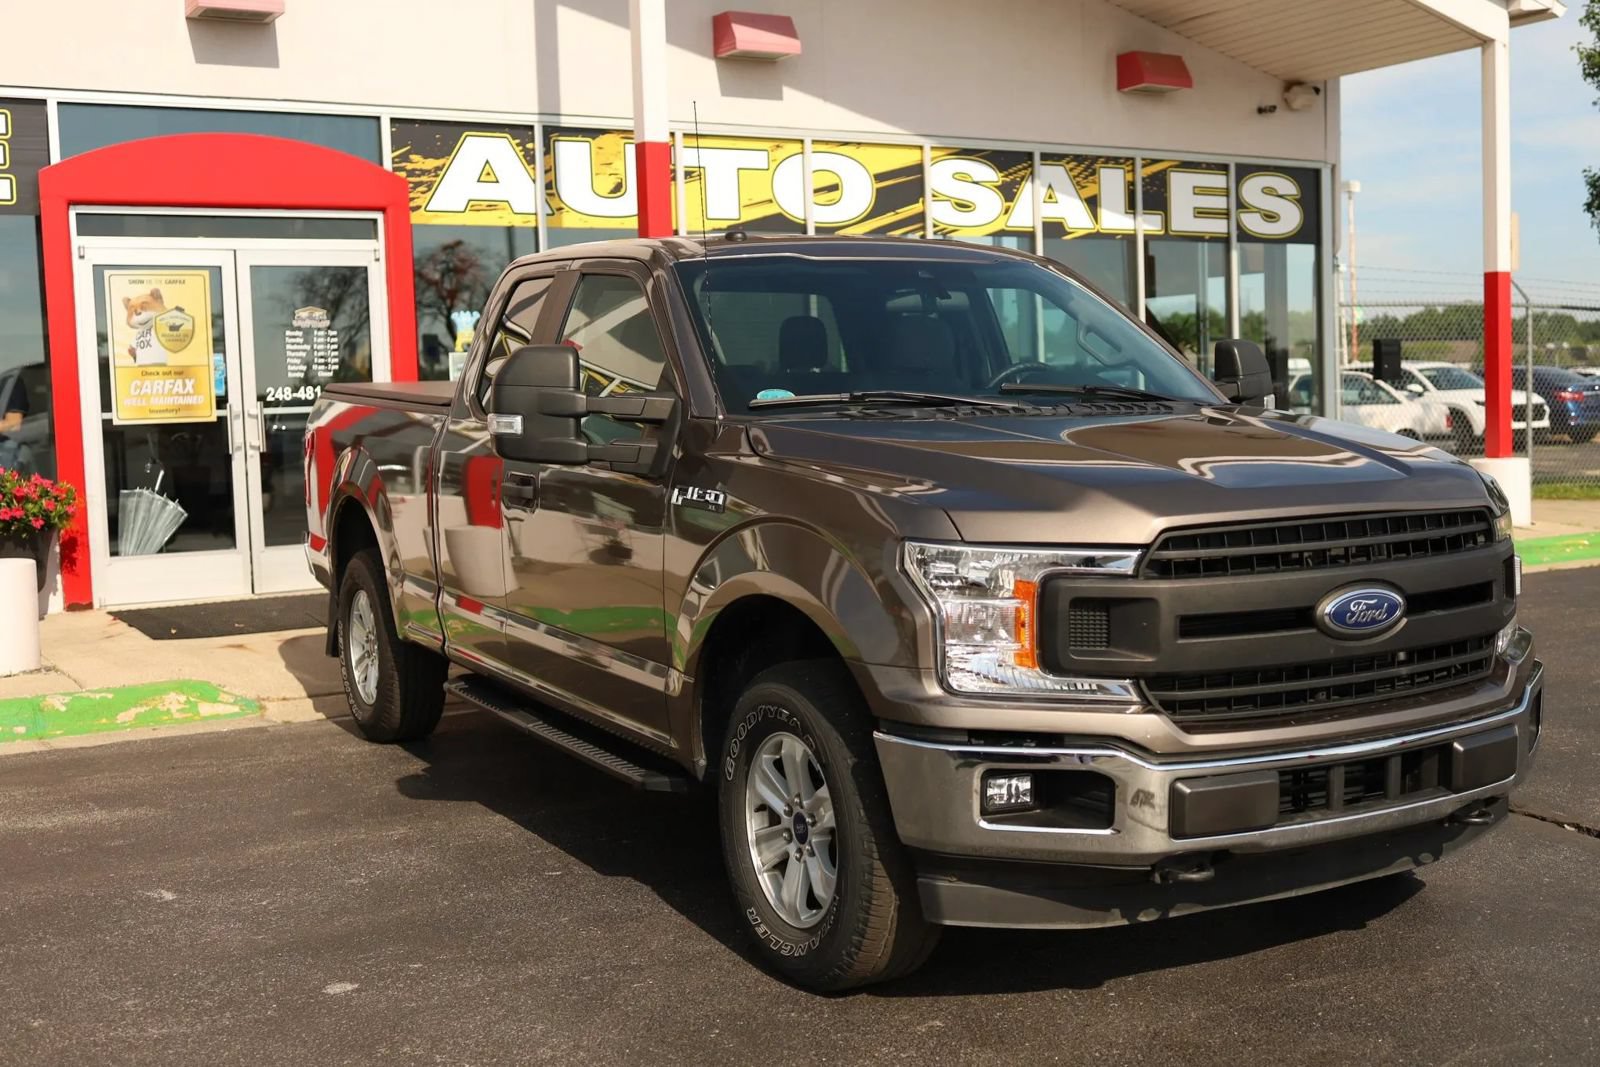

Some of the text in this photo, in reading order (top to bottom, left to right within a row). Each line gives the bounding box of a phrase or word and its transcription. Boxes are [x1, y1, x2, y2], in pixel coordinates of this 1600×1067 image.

[423, 131, 1304, 239] AUTO SALES
[130, 378, 196, 396] CARFAX
[124, 395, 204, 406] WELL MAINTAINED
[1346, 598, 1388, 624] Ford
